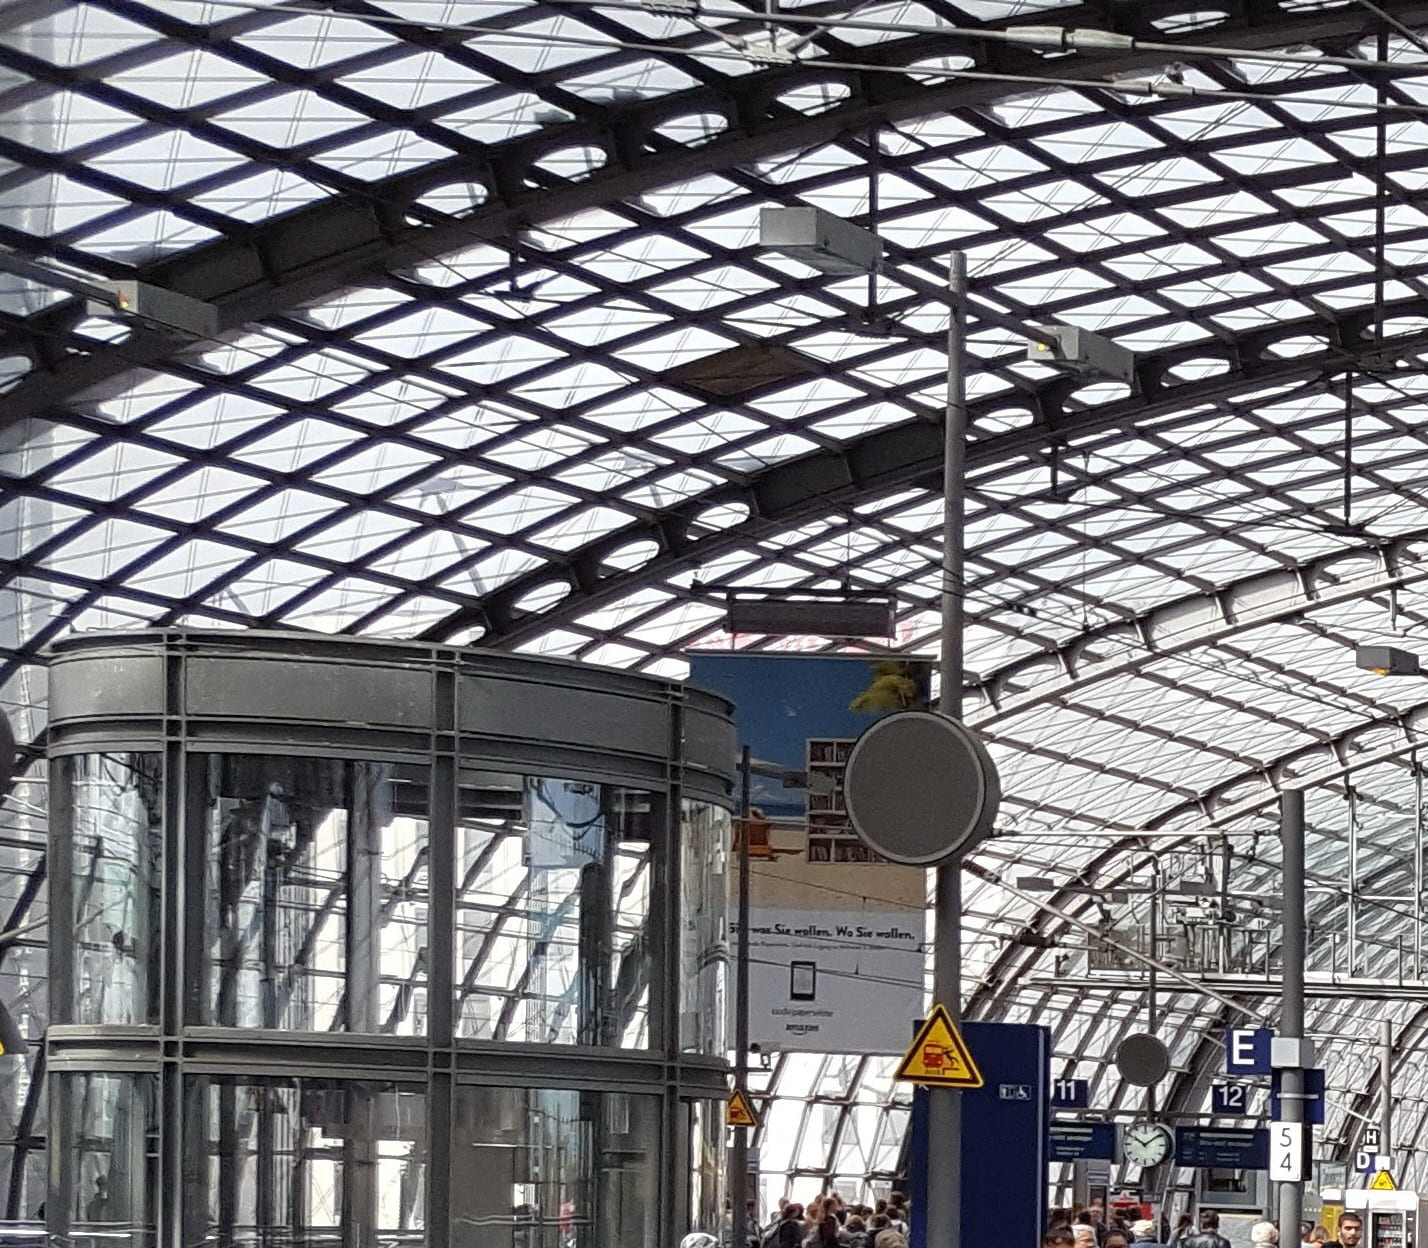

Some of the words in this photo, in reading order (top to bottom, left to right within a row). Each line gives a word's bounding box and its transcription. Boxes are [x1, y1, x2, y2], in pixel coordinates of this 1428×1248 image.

[836, 926, 853, 938] Wo
[856, 927, 872, 938] Sie
[1232, 1030, 1255, 1065] E
[1057, 1080, 1075, 1100] 11
[1218, 1086, 1243, 1107] 12
[1280, 1127, 1292, 1147] 5
[1366, 1131, 1377, 1144] H
[1280, 1152, 1292, 1172] 4
[1356, 1152, 1371, 1169] D
